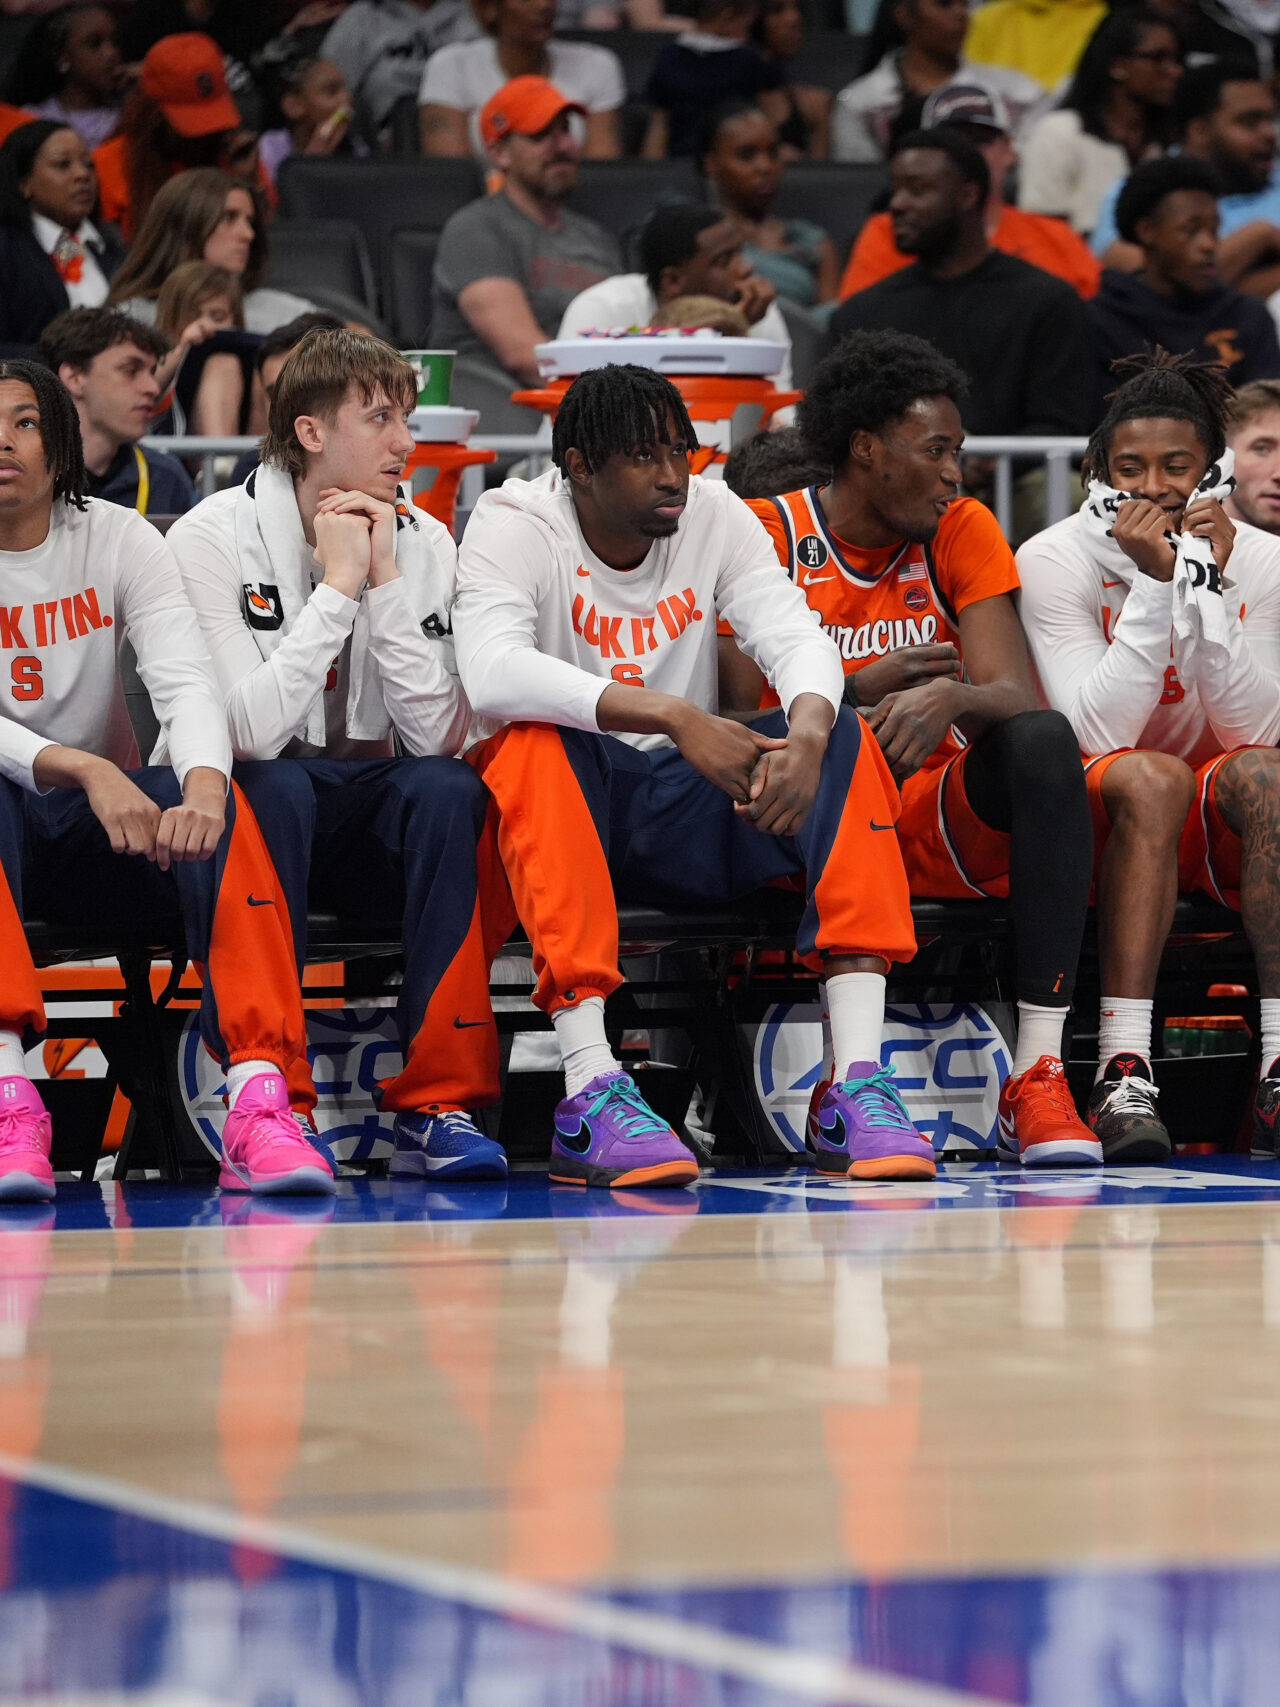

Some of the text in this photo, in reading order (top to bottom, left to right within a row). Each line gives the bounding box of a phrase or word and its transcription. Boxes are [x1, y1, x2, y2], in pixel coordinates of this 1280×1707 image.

[807, 538, 818, 550] LM
[808, 550, 819, 565] 21
[33, 602, 58, 647] IT
[60, 587, 113, 641] IN.
[631, 616, 659, 655] IT
[656, 587, 703, 641] IN.
[11, 656, 43, 701] S
